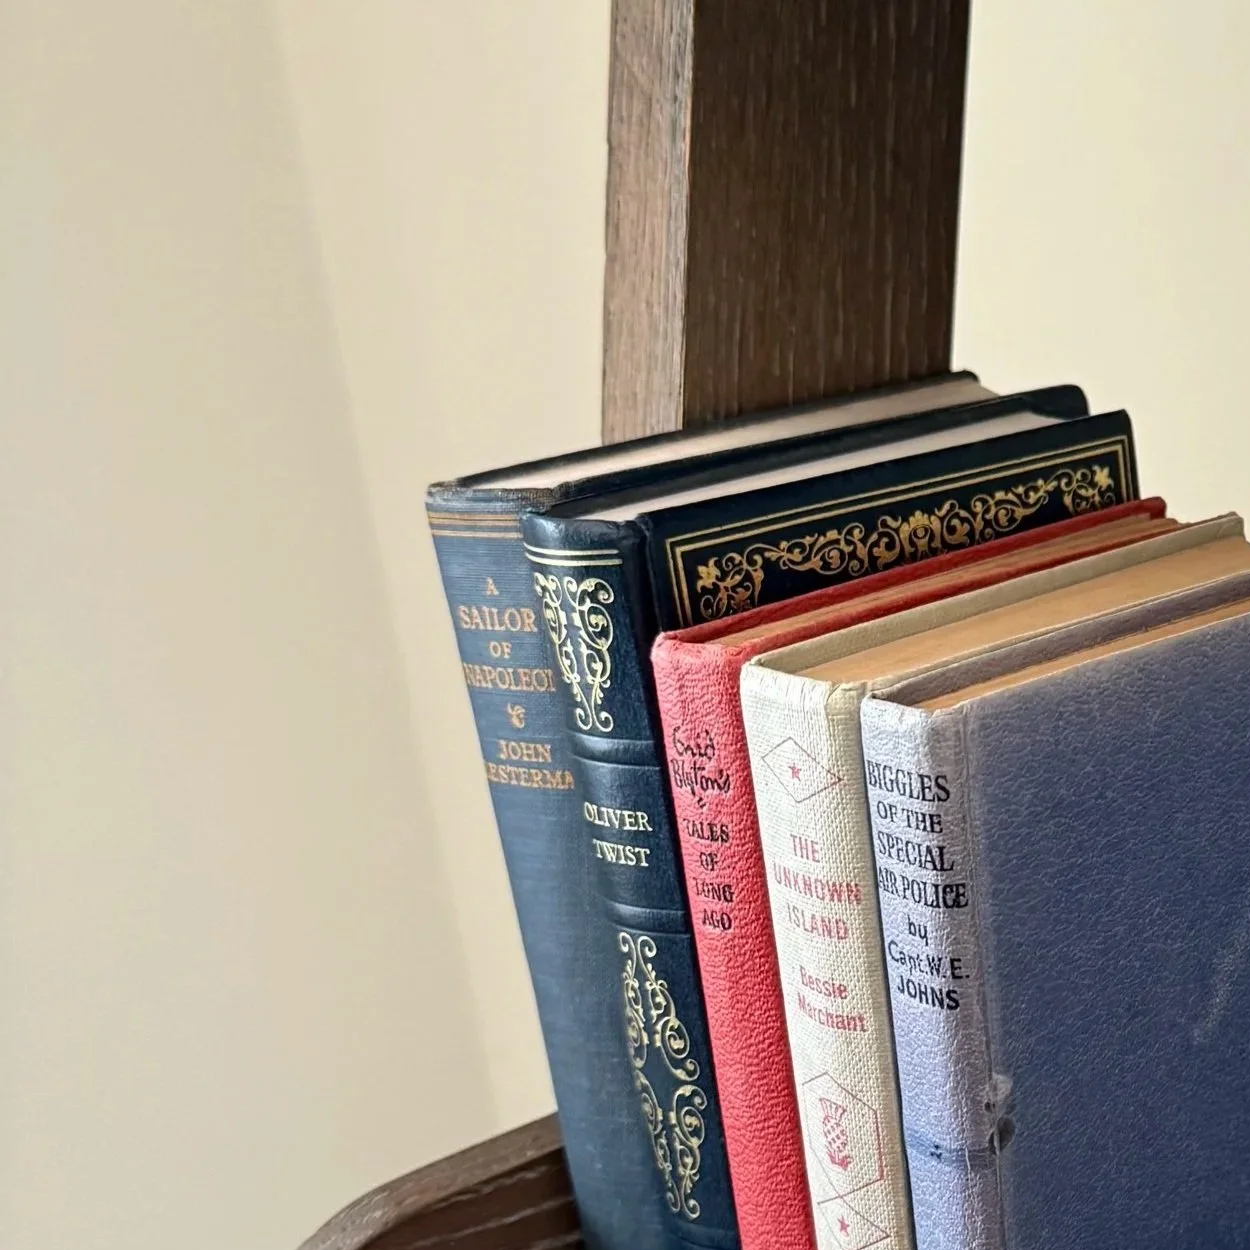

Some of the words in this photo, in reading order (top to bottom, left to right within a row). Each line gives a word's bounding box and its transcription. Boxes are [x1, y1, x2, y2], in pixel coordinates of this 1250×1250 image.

[486, 577, 499, 596] A
[459, 605, 538, 633] SAILOR
[489, 640, 512, 659] OF
[496, 739, 552, 763] JOHN
[672, 726, 716, 762] Enid
[867, 759, 951, 802] BIGGLES
[584, 801, 653, 832] OLIVER
[683, 818, 730, 843] TALES
[877, 801, 899, 823] OF
[901, 808, 944, 834] THE
[592, 838, 650, 867] TWIST
[699, 851, 719, 873] OF
[790, 834, 821, 864] THE
[877, 831, 955, 872] SPECIAL
[694, 877, 735, 903] LONG
[773, 862, 865, 906] UNKNOWN
[877, 866, 901, 899] AIR
[901, 879, 970, 910] POLICE
[702, 908, 733, 931] AGO
[787, 902, 850, 942] ISLAND
[907, 915, 930, 946] by
[800, 966, 848, 1001] Bessie
[897, 976, 962, 1012] JOHNS
[797, 991, 870, 1034] Marchant
